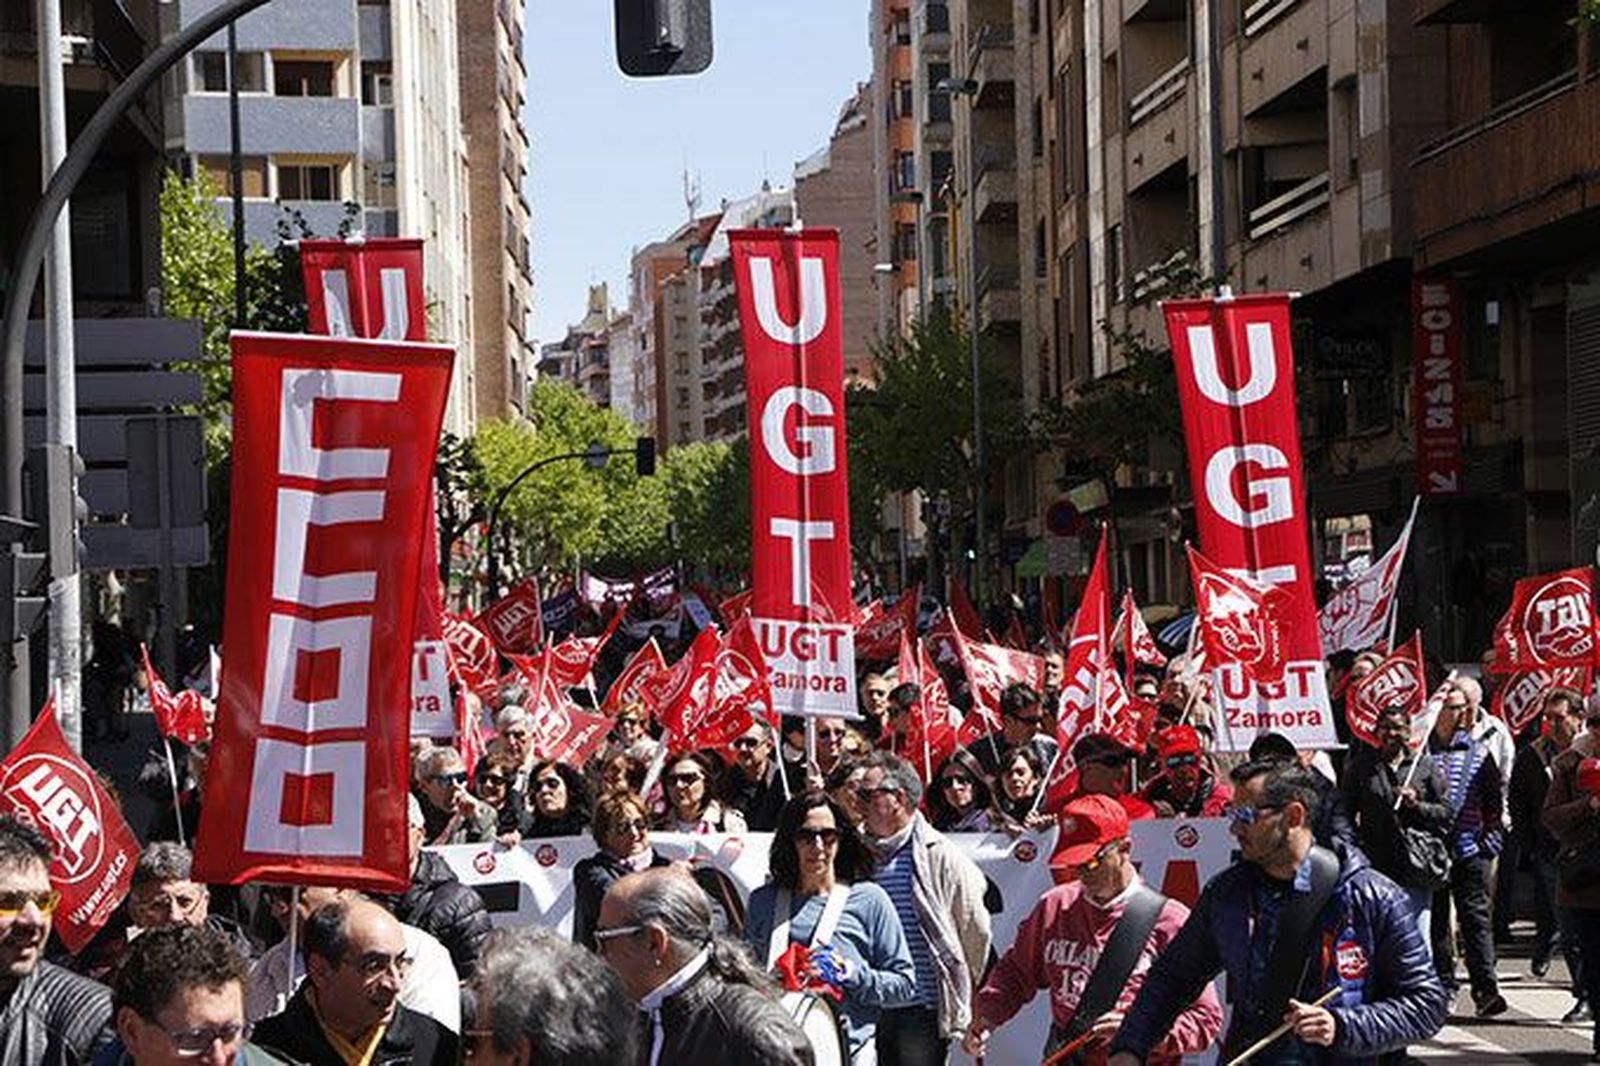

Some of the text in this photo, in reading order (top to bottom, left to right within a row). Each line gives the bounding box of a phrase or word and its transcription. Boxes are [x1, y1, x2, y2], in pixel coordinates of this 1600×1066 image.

[748, 257, 836, 606] UGT
[243, 368, 402, 857] CCOO
[761, 623, 845, 662] UGT
[767, 666, 847, 693] amora
[1226, 708, 1321, 728] Zamora
[20, 763, 99, 852] UGT
